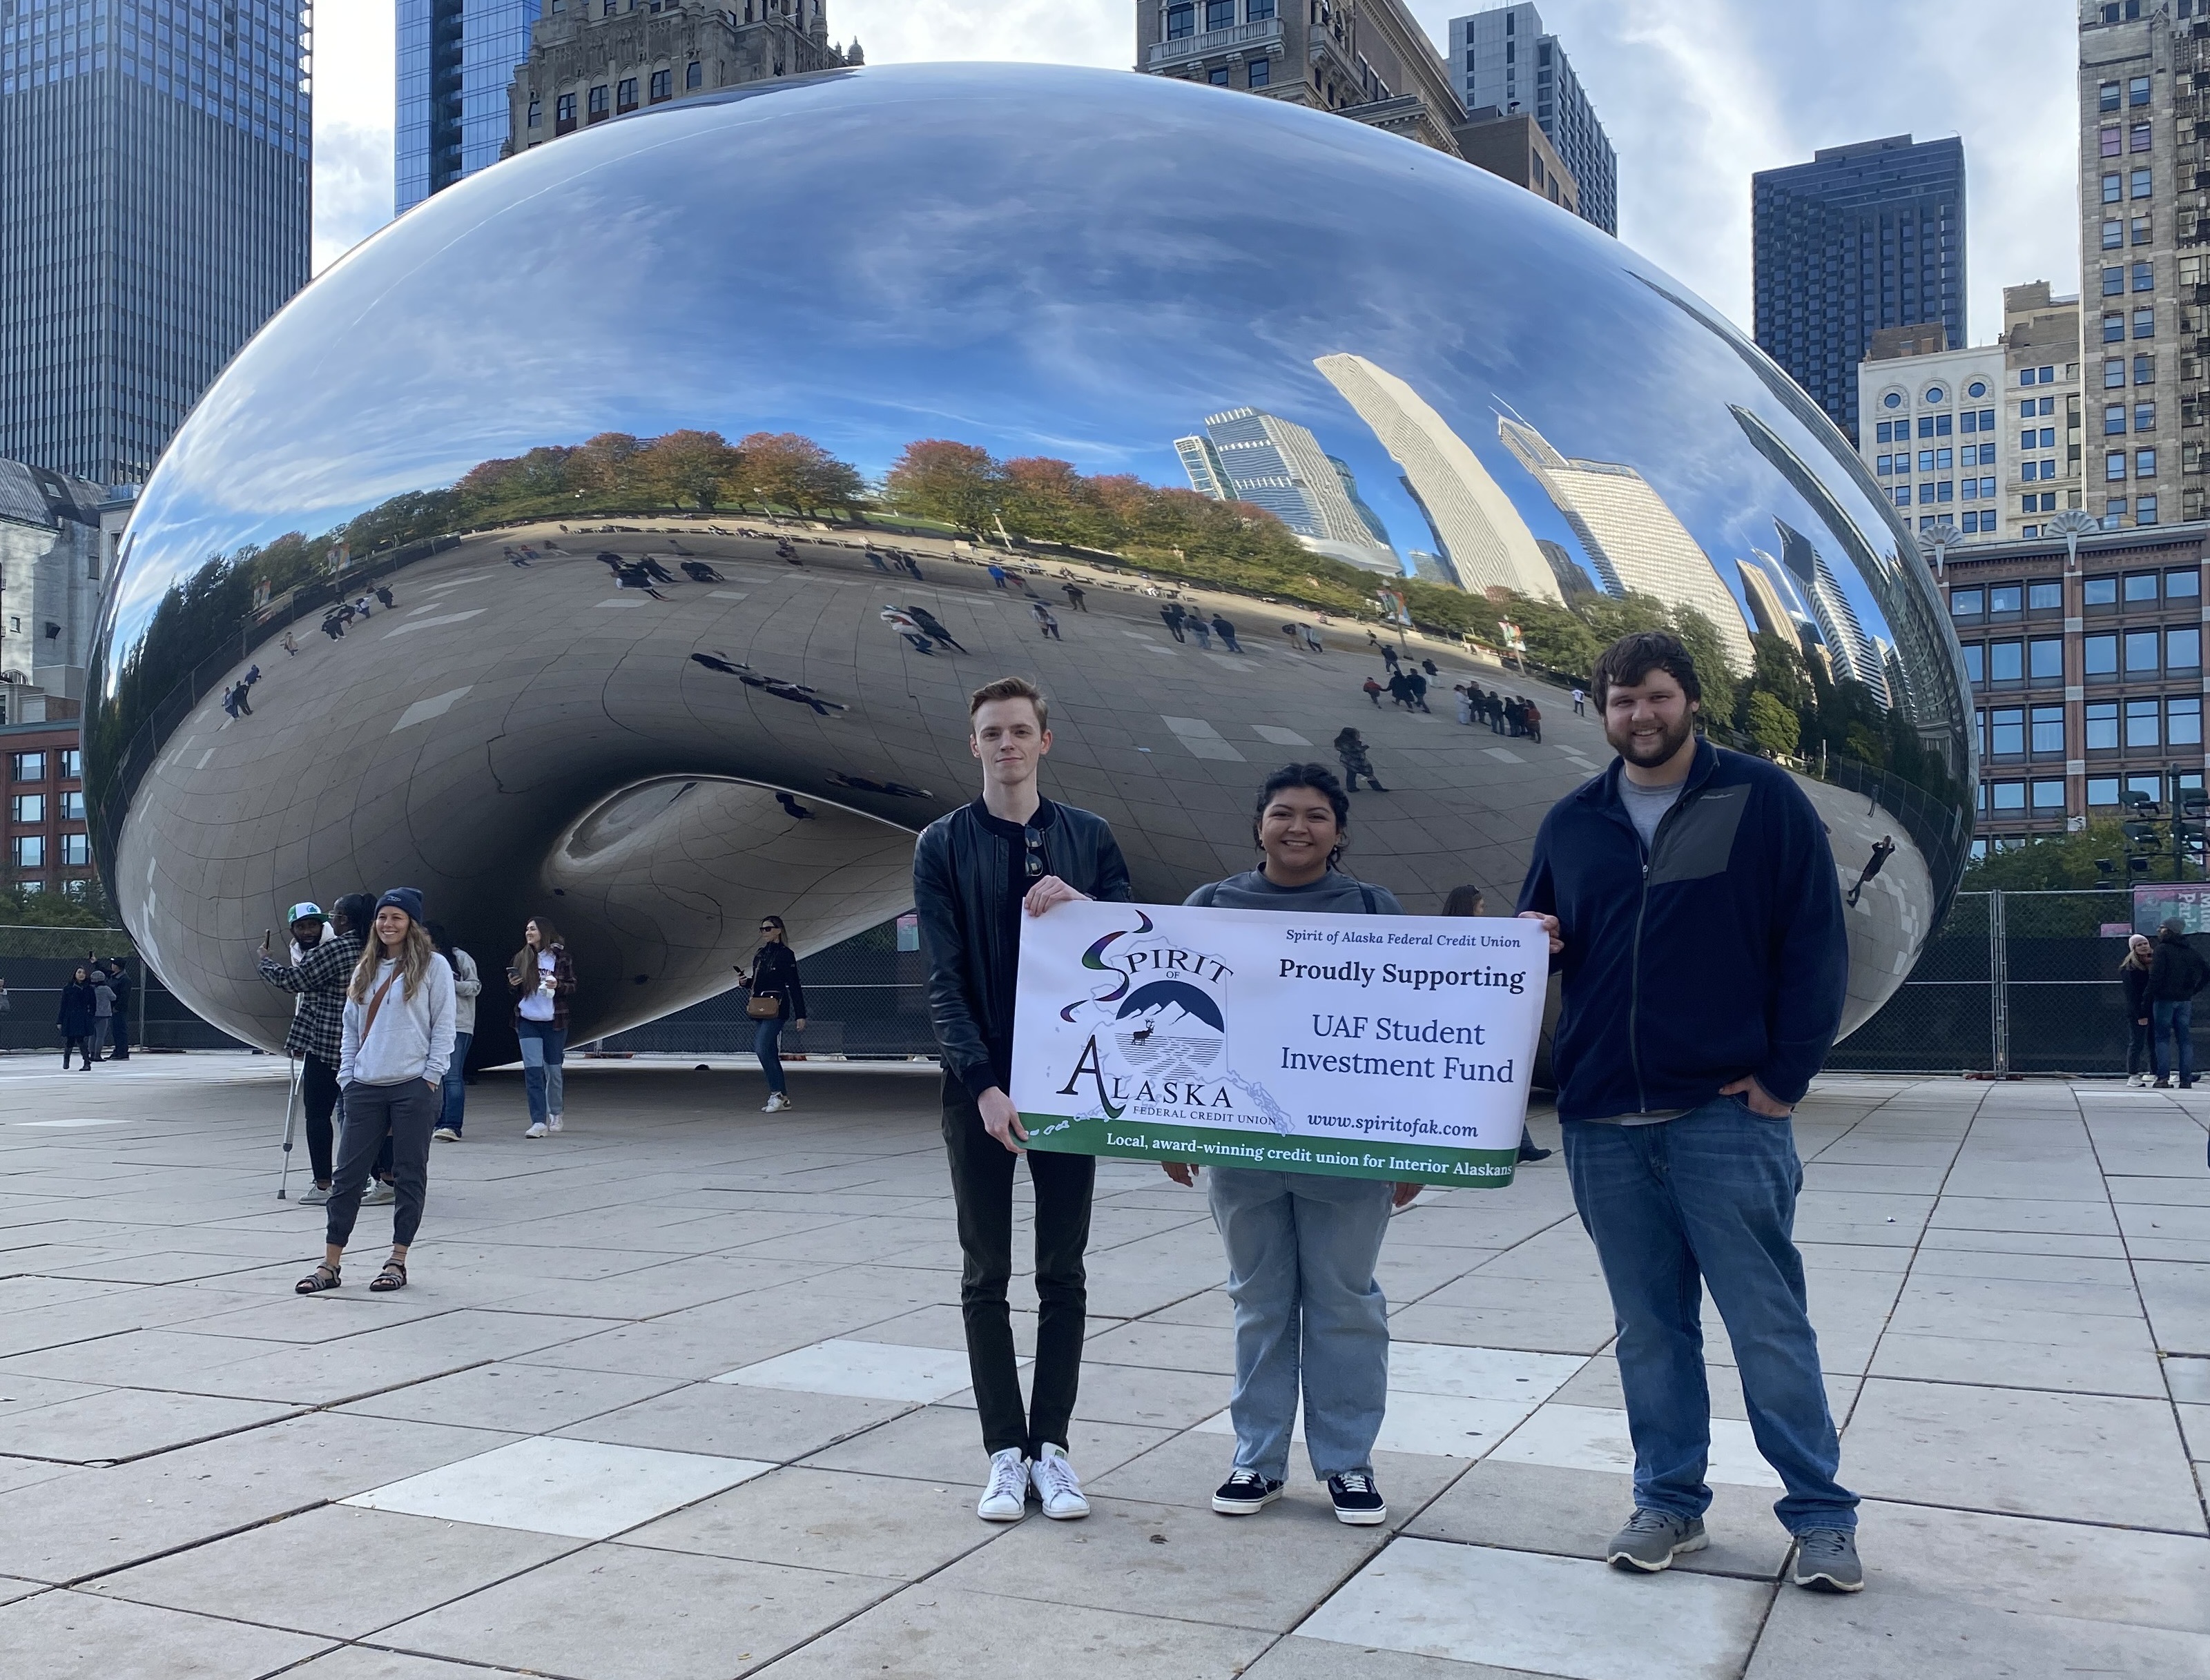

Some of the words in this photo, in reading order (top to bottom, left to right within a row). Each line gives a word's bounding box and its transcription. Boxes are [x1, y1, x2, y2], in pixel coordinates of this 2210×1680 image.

[1286, 929, 1324, 944] Spirit
[1326, 930, 1341, 946] of
[1341, 931, 1384, 944] Alaska
[1387, 933, 1433, 946] Federal
[1437, 935, 1477, 947] Credit
[1481, 935, 1521, 948] Union
[1165, 970, 1181, 979] OF
[1279, 958, 1376, 988] Proudly
[1382, 963, 1526, 995] Supporting
[1312, 1014, 1368, 1039] UAF
[1376, 1017, 1486, 1046] Student
[1281, 1046, 1435, 1078] Investment
[1443, 1056, 1515, 1083] Fund
[1133, 1106, 1187, 1119] FEDERAL
[1190, 1111, 1234, 1123] CREDIT
[1238, 1115, 1277, 1126] UNION
[1307, 1113, 1479, 1137] www.spiritofak.com
[1107, 1133, 1149, 1151] Local,
[1152, 1140, 1265, 1162] award-winning
[1268, 1148, 1312, 1162] credit
[1315, 1151, 1359, 1166] union
[1363, 1153, 1386, 1169] for
[1389, 1156, 1449, 1174] Interior
[1453, 1162, 1513, 1177] Alaskans
